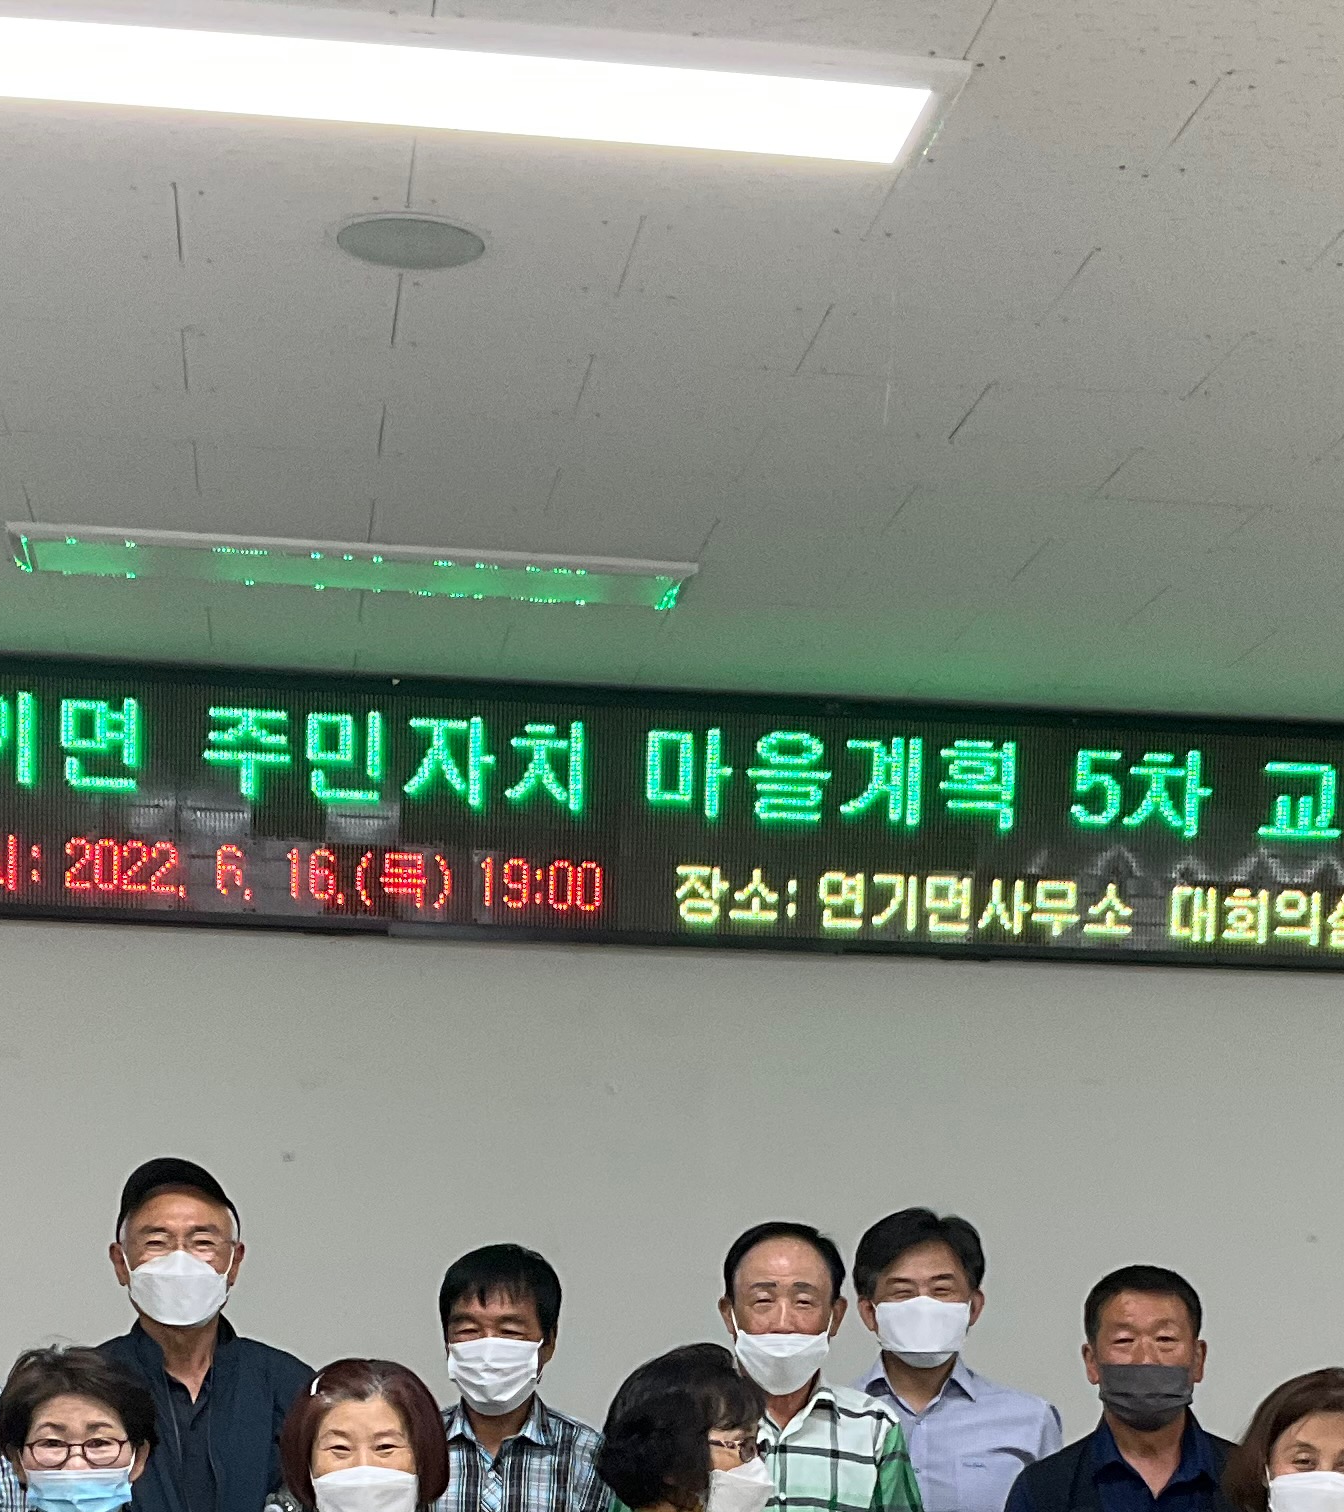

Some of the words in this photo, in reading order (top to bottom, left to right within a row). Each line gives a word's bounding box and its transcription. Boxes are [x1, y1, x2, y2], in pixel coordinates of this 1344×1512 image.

[202, 705, 586, 815] 주민자치
[644, 726, 1018, 832] 마을계획
[1068, 748, 1214, 839] 5차
[481, 856, 605, 912] 19:00
[674, 864, 798, 924] 장소:
[817, 870, 1134, 937] 연기면사무소
